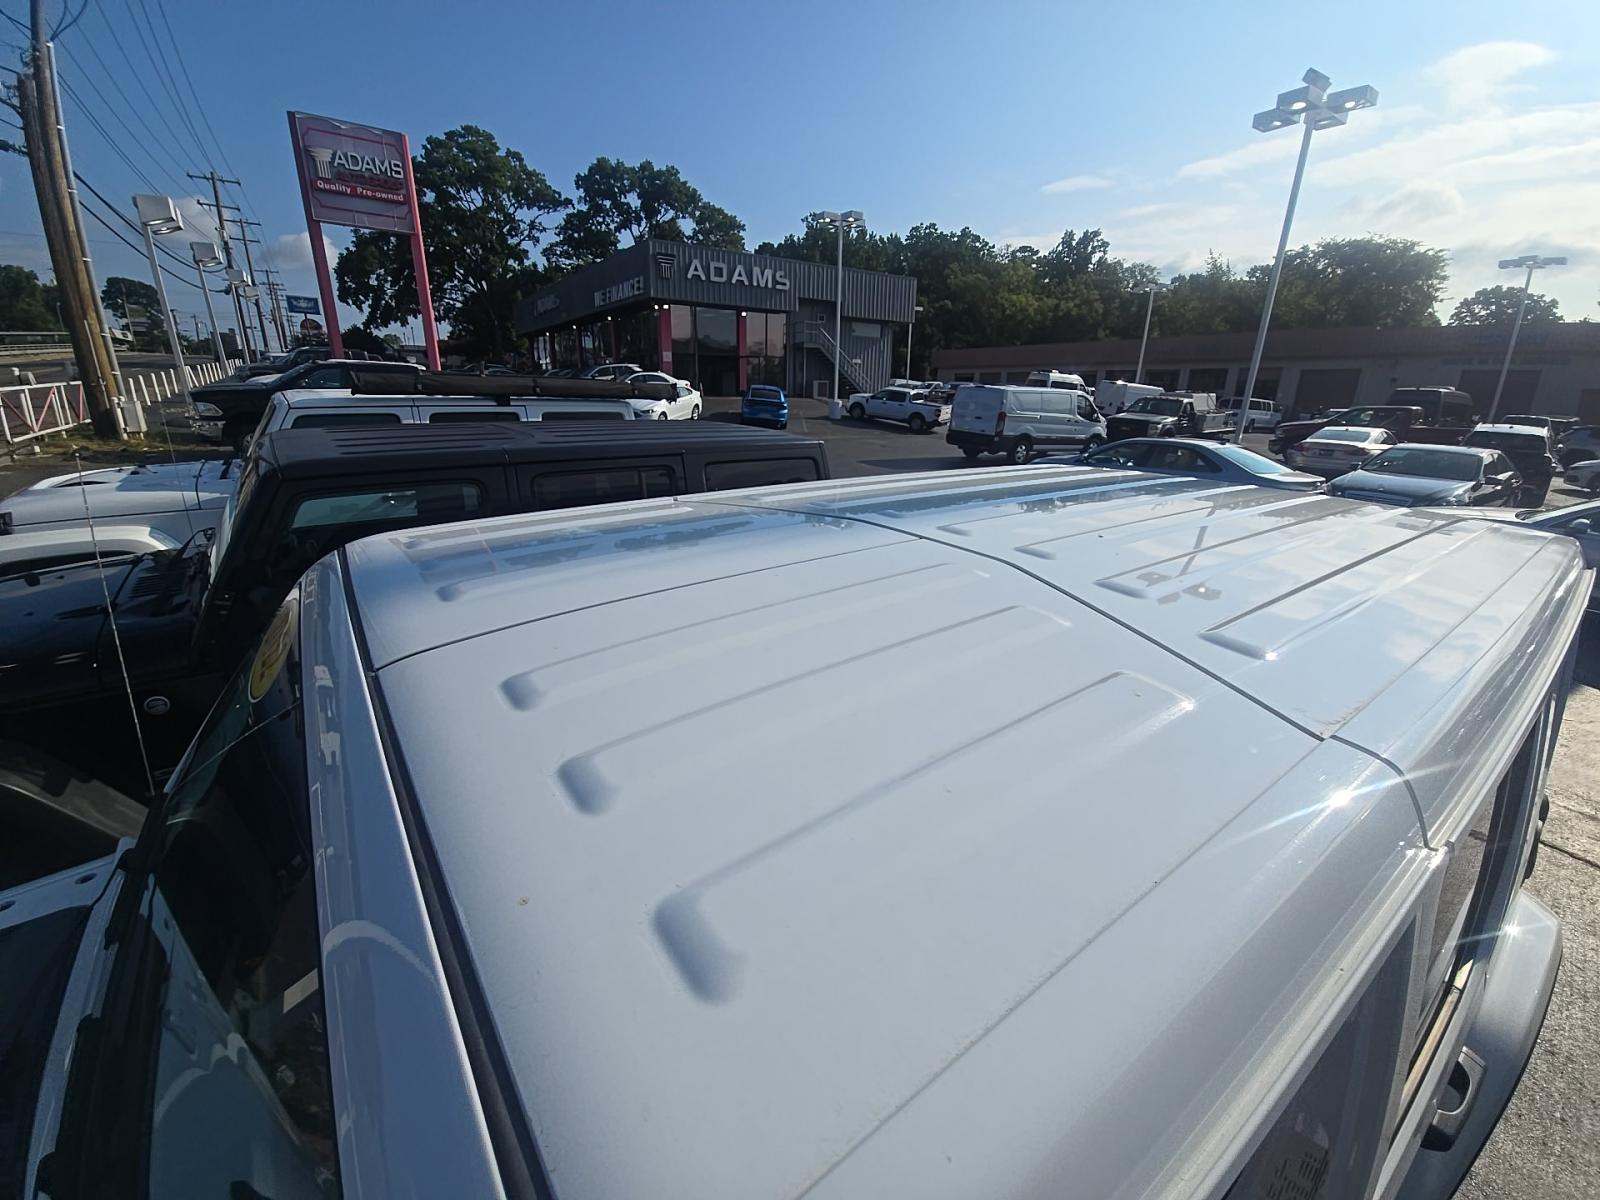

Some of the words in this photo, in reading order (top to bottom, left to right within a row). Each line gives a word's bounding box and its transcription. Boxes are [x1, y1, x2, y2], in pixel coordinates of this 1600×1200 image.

[333, 150, 404, 179] ADAMS
[317, 180, 351, 194] Quality
[357, 187, 404, 201] Pre-owned
[687, 258, 790, 291] ADAMS
